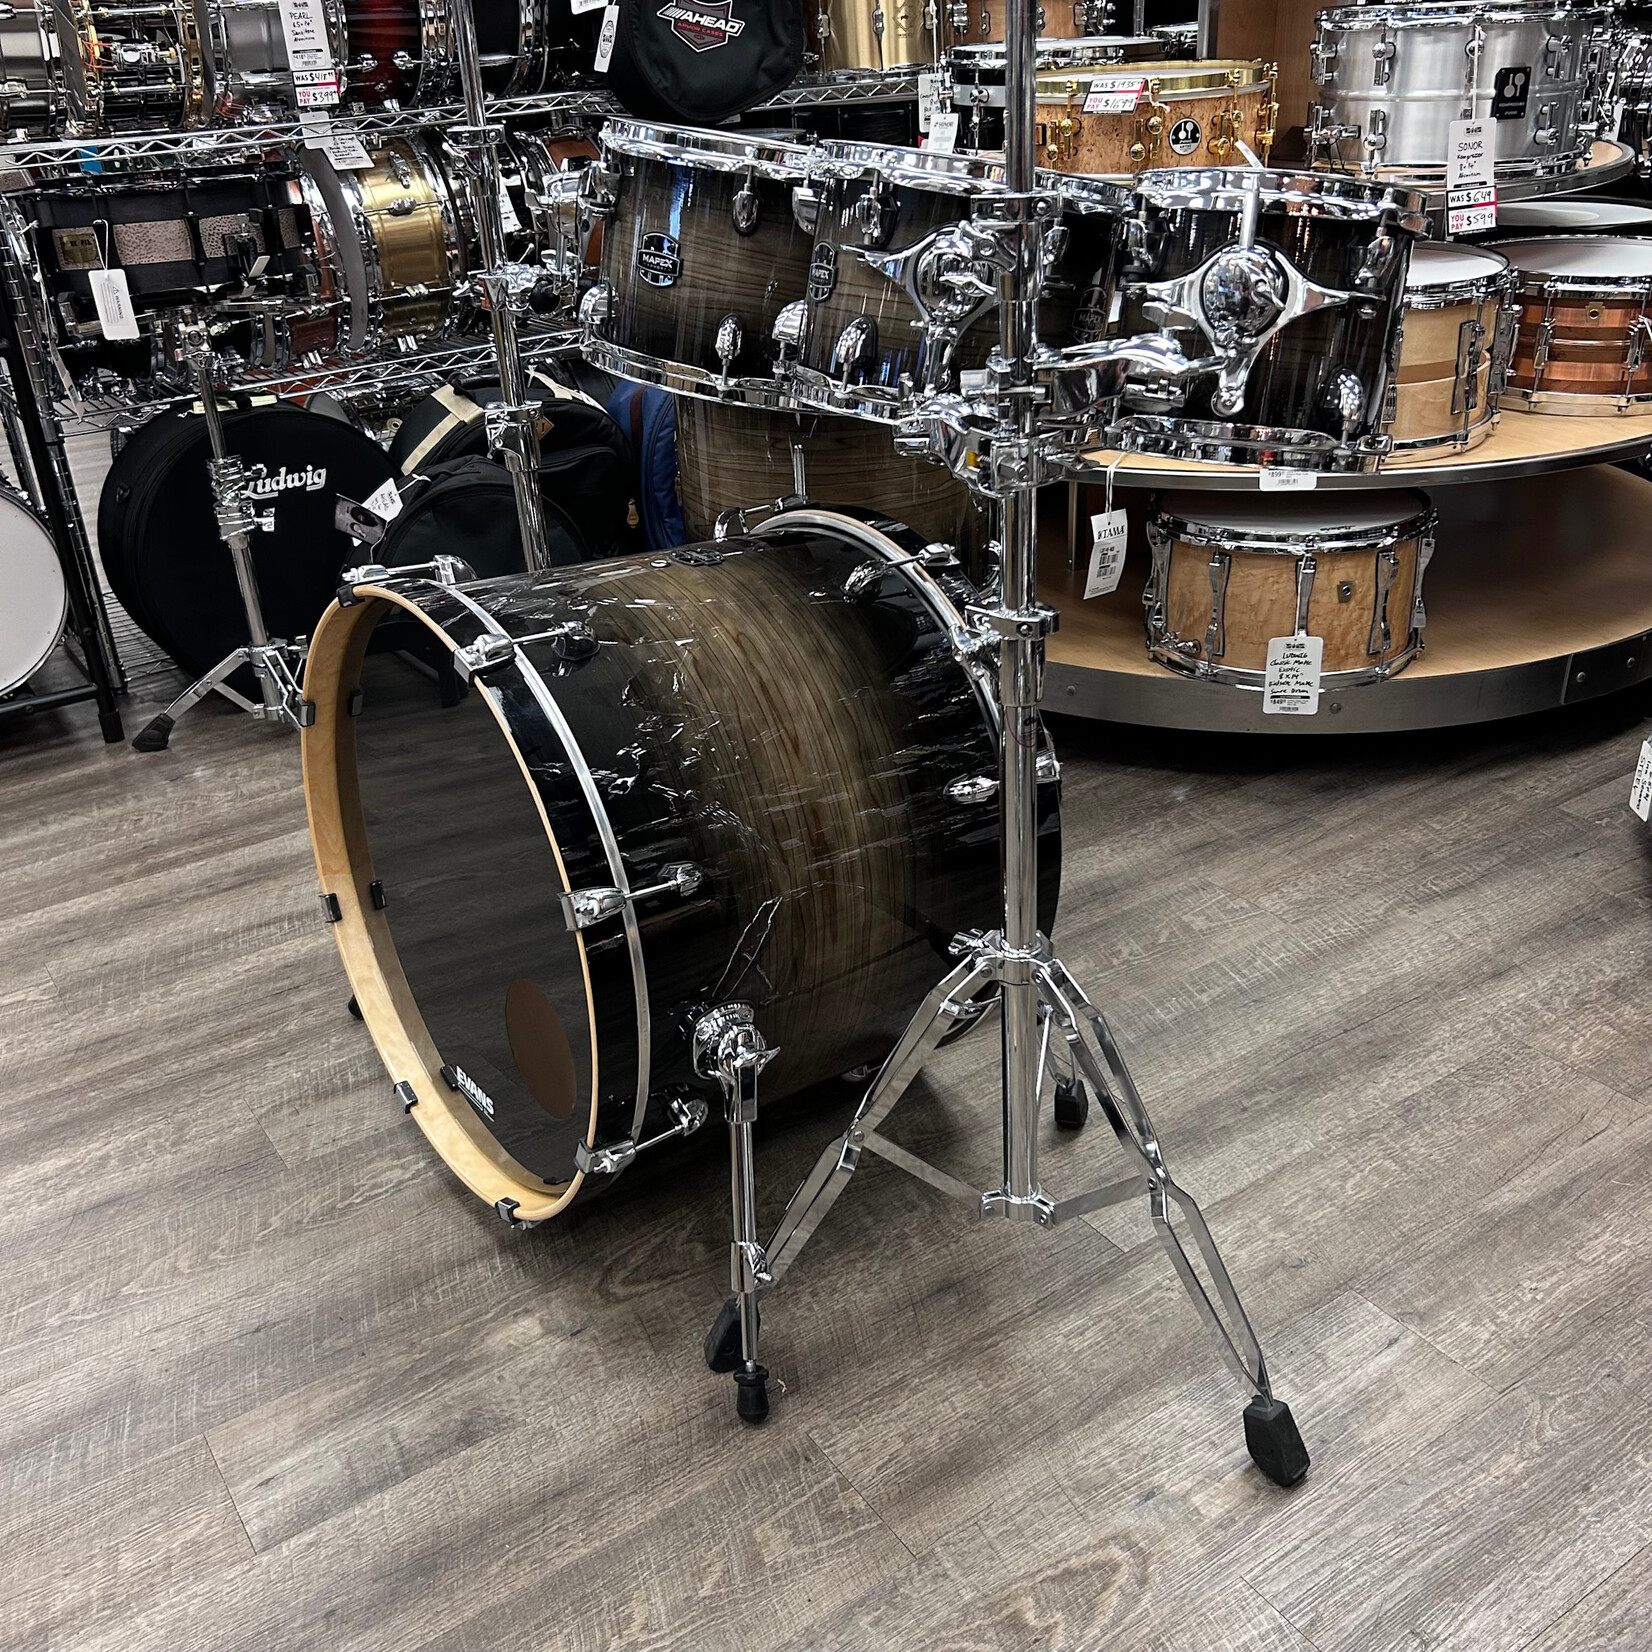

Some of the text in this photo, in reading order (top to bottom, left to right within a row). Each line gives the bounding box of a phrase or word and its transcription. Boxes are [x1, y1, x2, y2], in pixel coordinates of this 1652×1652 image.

[289, 11, 313, 20] PEARL
[680, 11, 742, 33] AHEAD
[677, 22, 724, 37] ARMOR CASES
[295, 74, 309, 82] WAS
[1458, 140, 1484, 152] SONOR
[1450, 194, 1465, 203] WAS
[1451, 214, 1465, 222] YOU
[1451, 212, 1493, 230] PAY $599
[642, 253, 674, 269] MAPEX
[240, 464, 327, 500] Ludwig
[1102, 525, 1125, 539] TAMA
[456, 1065, 495, 1115] EVANS
